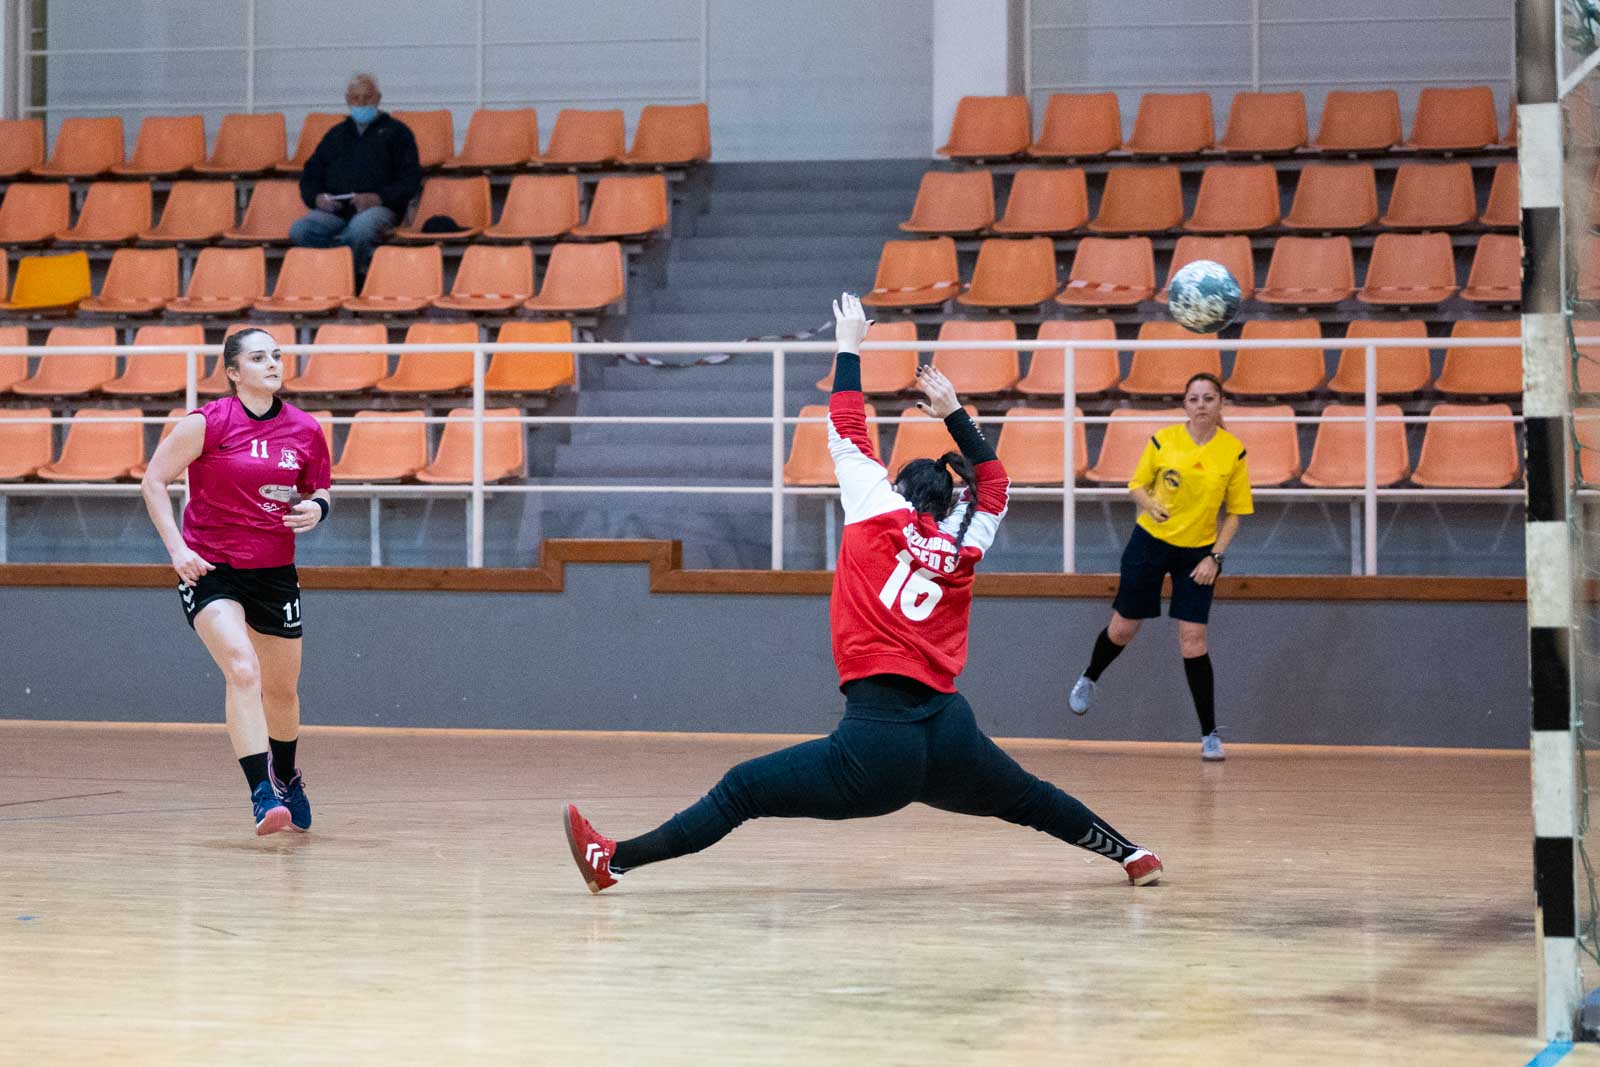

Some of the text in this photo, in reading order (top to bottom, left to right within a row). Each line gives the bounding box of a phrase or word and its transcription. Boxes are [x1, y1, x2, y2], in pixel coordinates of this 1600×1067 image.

[250, 438, 269, 459] 11
[879, 549, 944, 622] 16
[282, 598, 300, 621] 11
